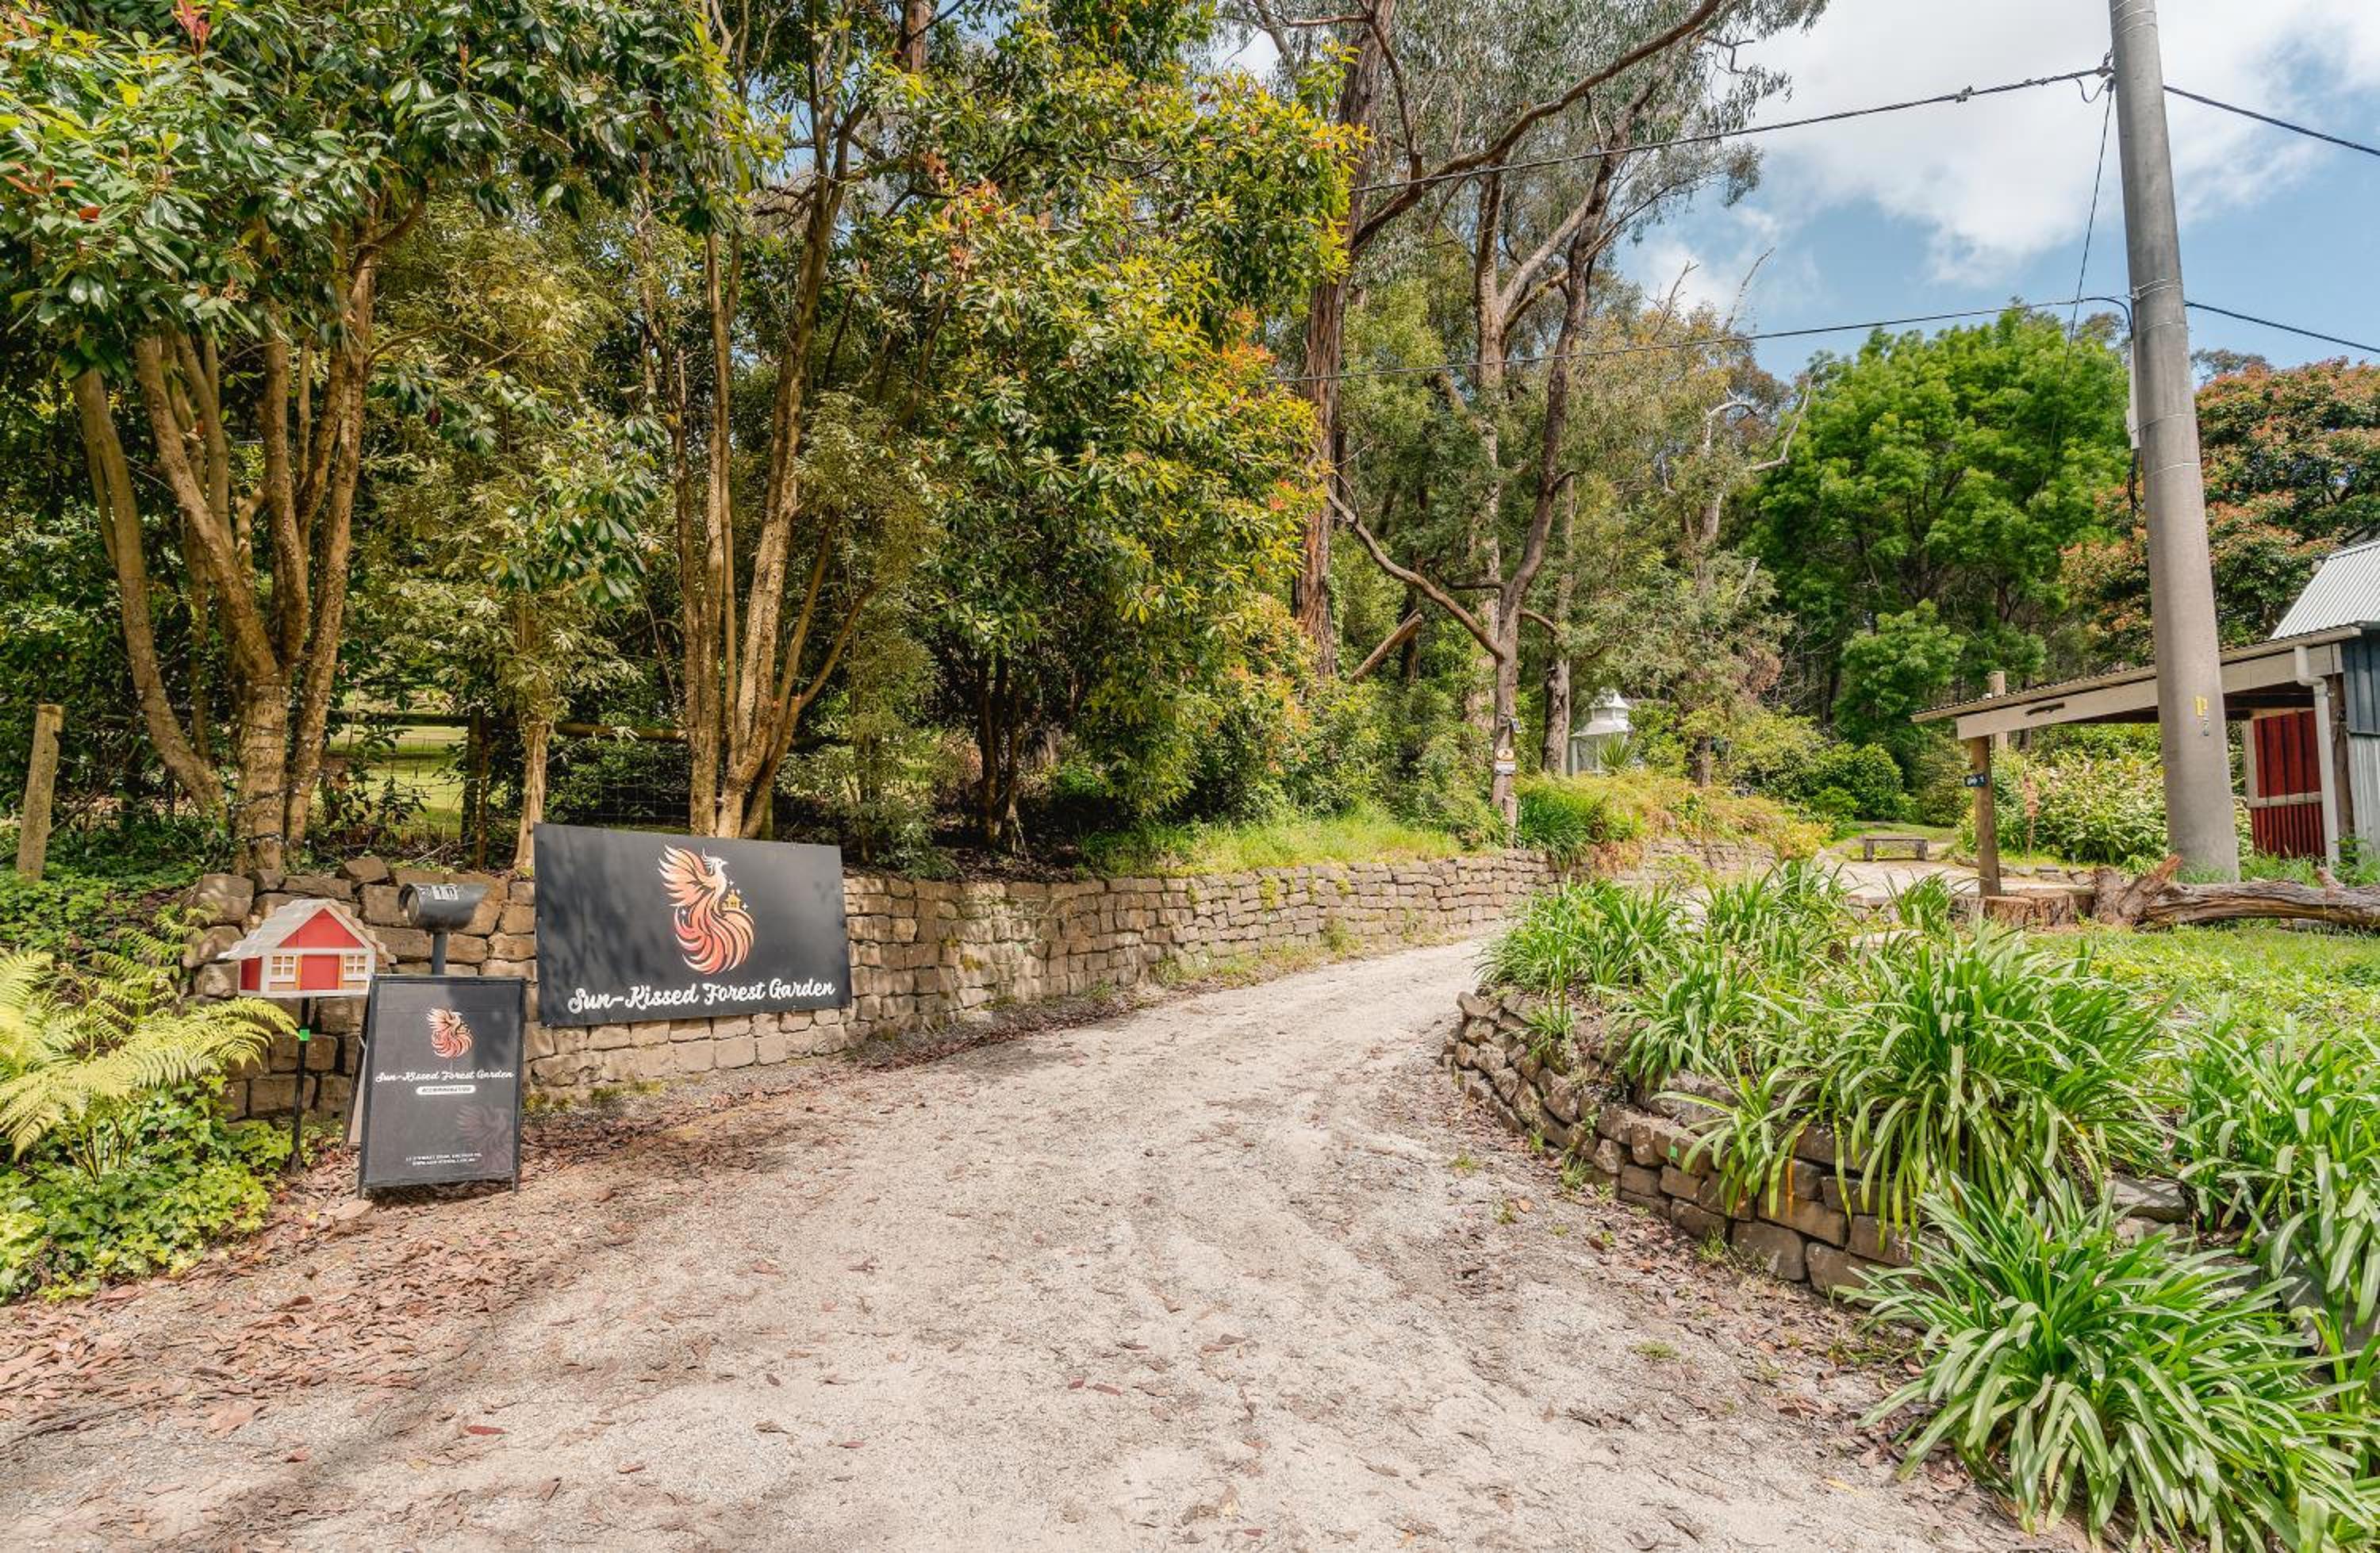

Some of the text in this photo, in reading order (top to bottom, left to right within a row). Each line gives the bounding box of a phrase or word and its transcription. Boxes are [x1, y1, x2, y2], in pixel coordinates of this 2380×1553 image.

[567, 977, 836, 1014] Sun-Kissed Forest Garden
[375, 1069, 515, 1083] Sun-Kissed Forest Garden
